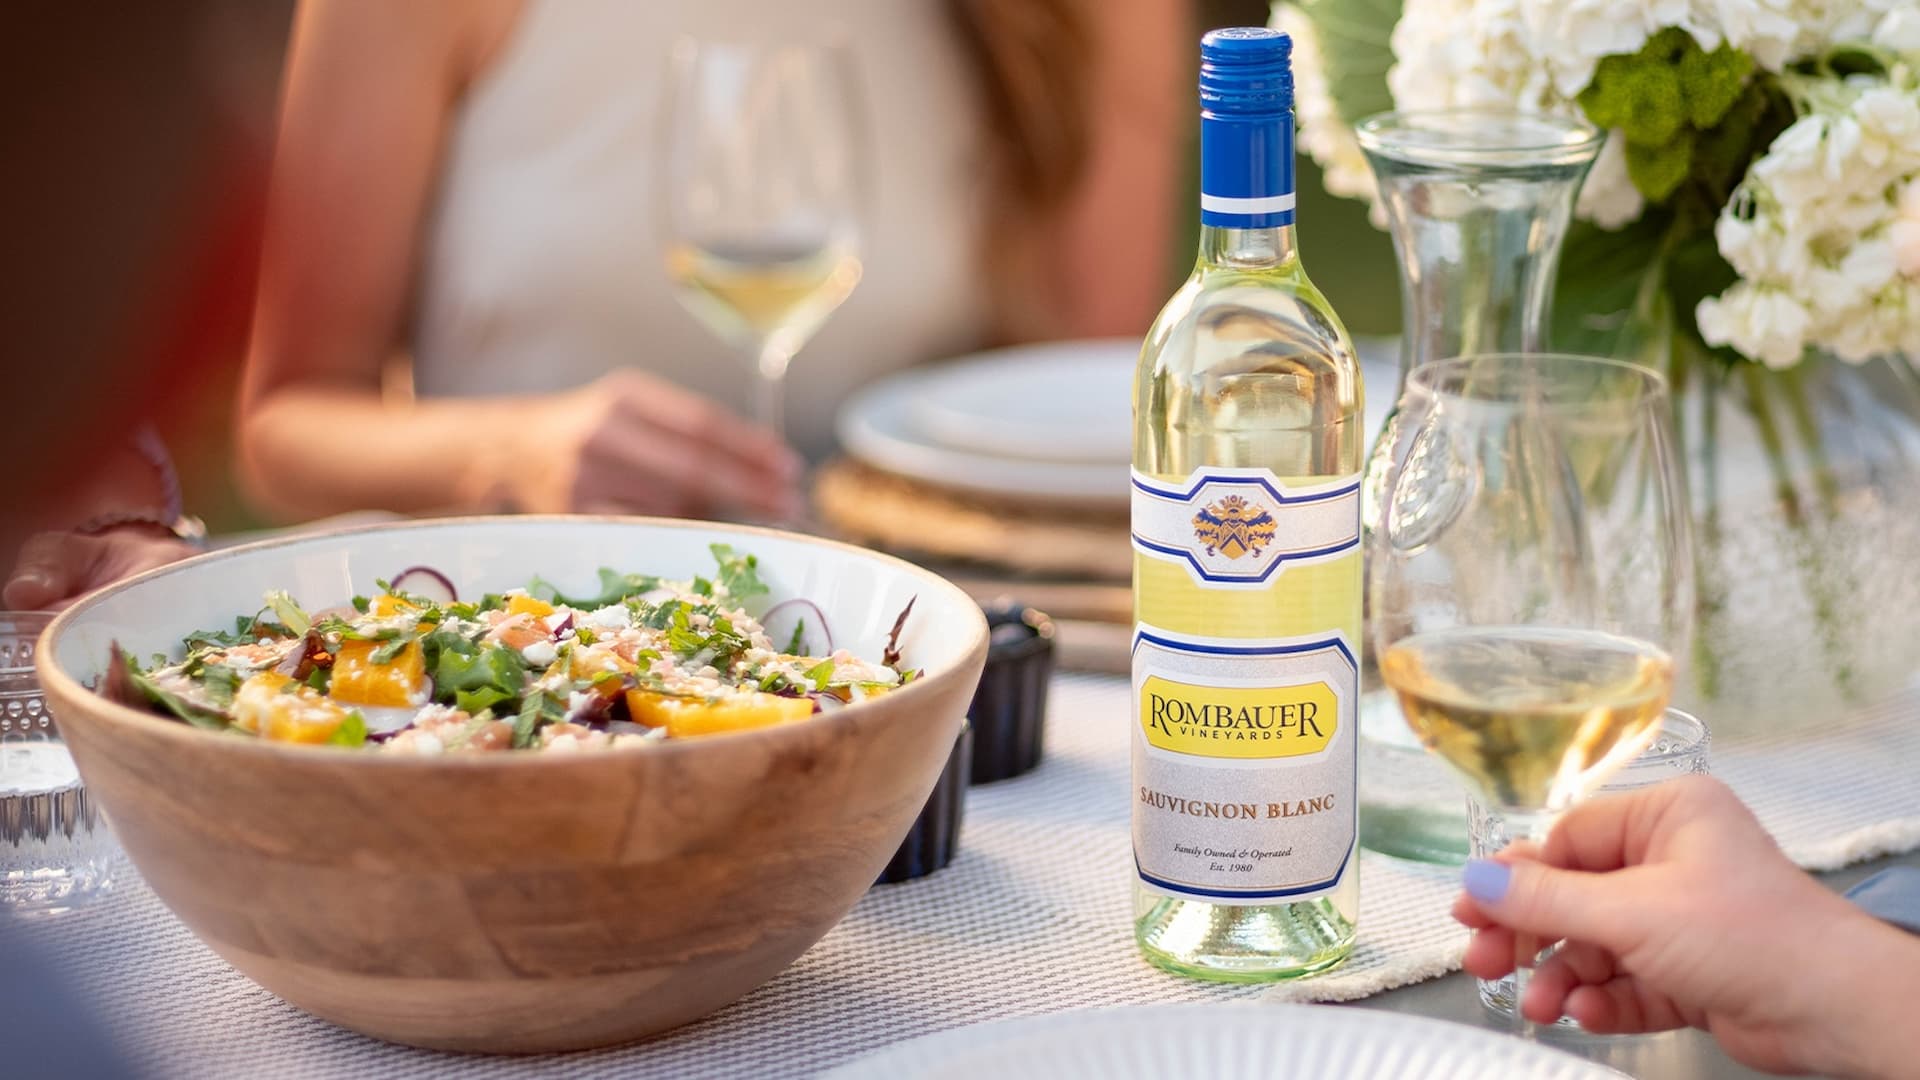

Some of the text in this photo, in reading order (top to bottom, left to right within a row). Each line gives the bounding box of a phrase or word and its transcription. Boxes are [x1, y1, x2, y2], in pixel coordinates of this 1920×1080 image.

[1150, 693, 1324, 737] ROMBAUER
[1180, 727, 1283, 740] VINEYARDS
[1140, 787, 1335, 819] SAUVIGNON BLANC
[1174, 843, 1293, 860] Family Owned & Operated
[1209, 862, 1253, 873] Est. 1980
